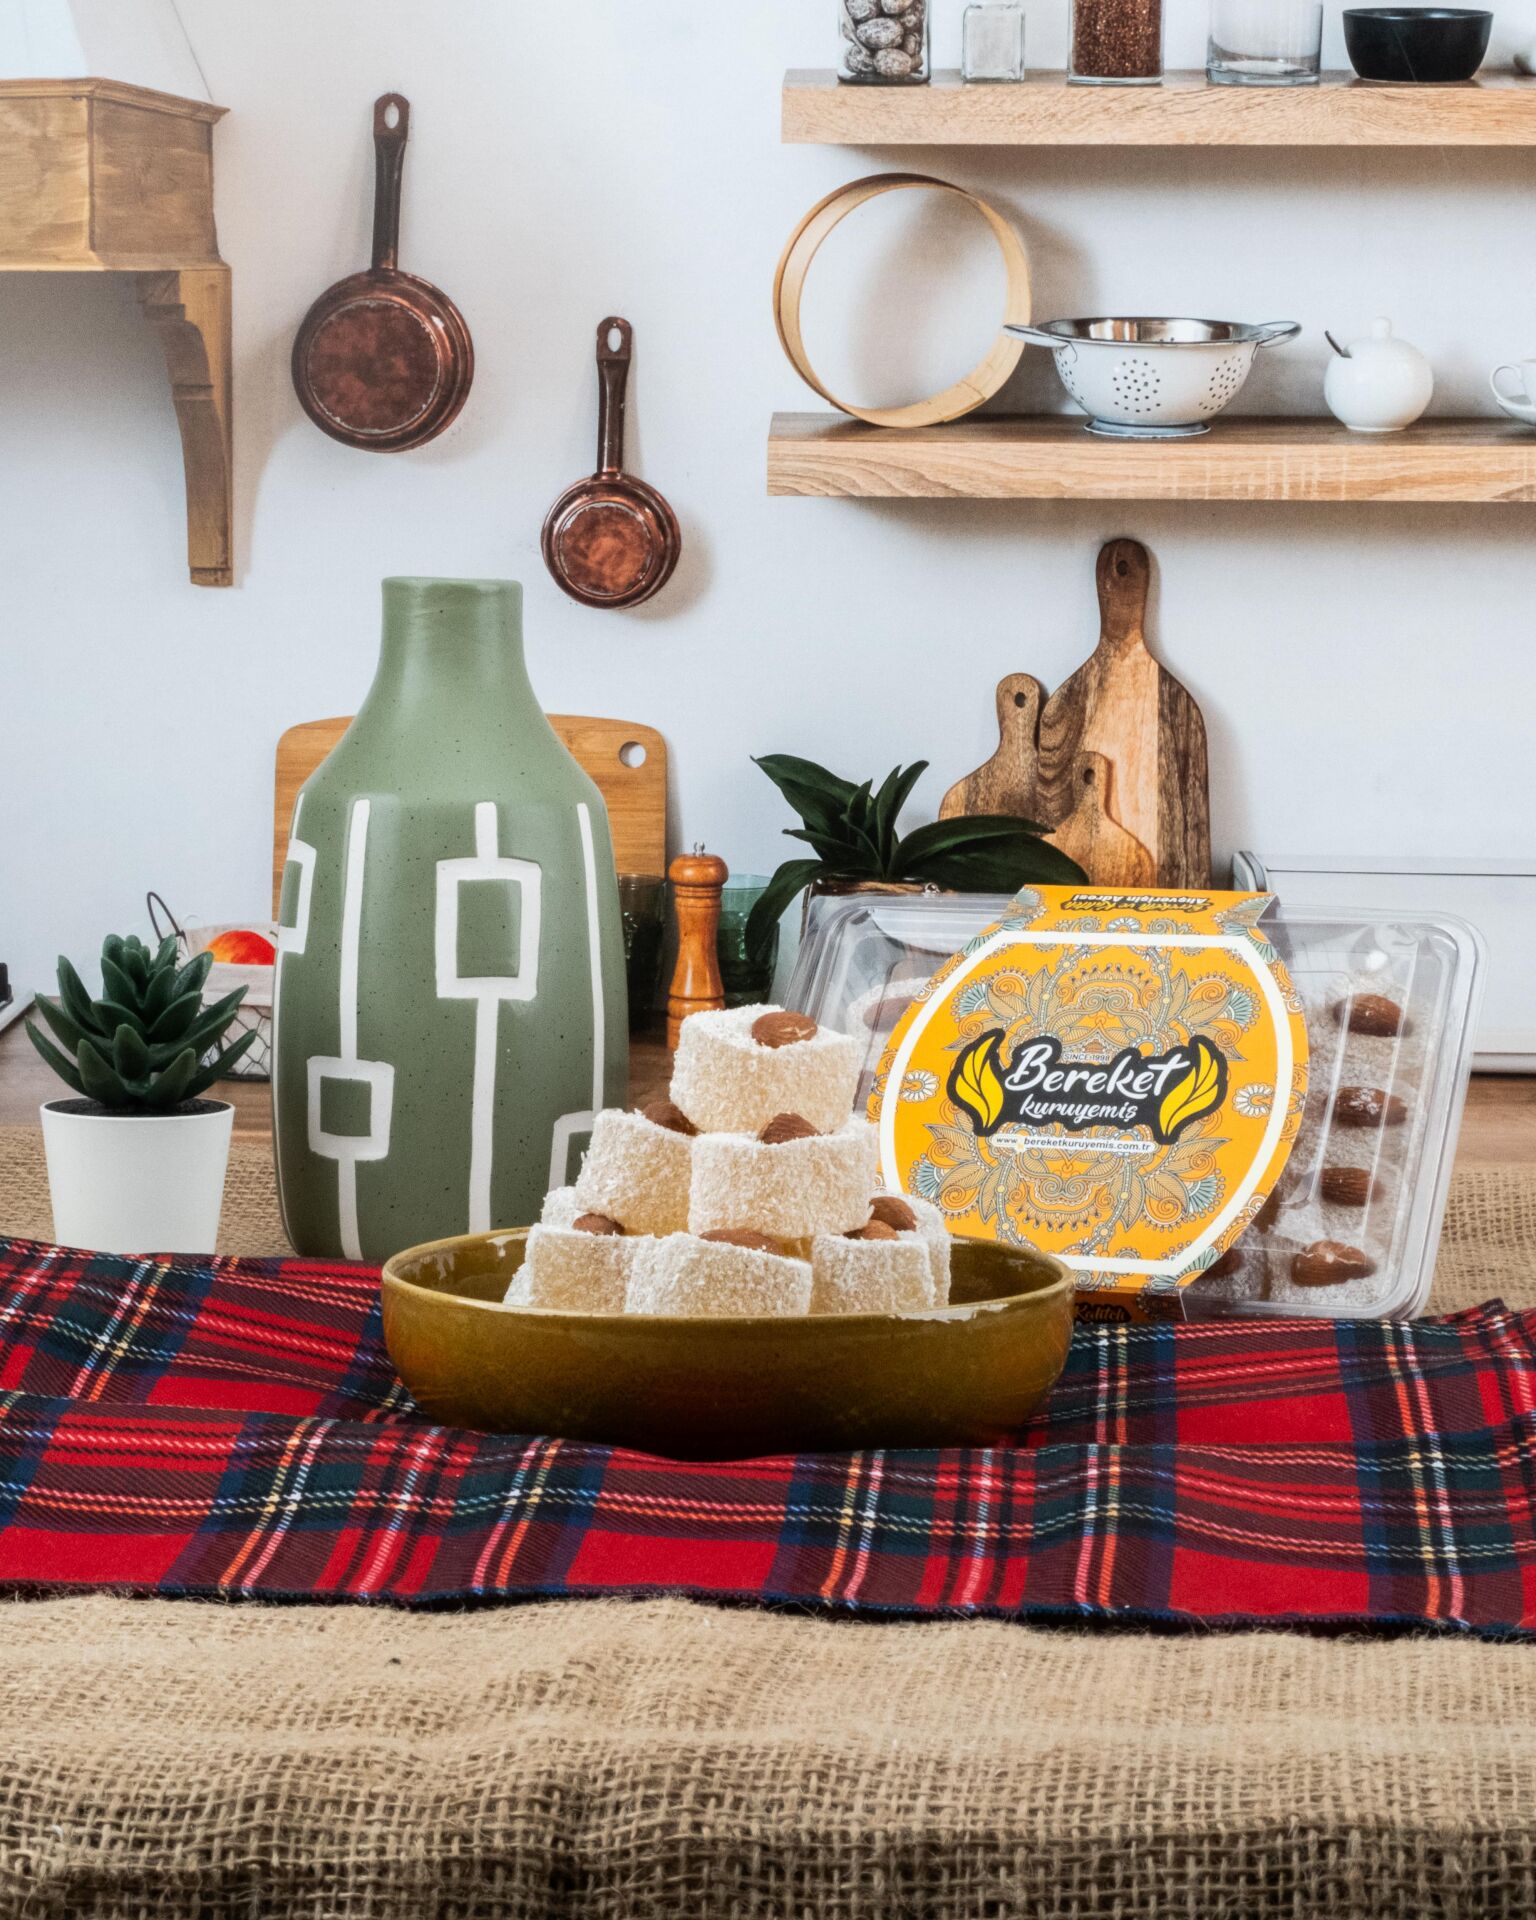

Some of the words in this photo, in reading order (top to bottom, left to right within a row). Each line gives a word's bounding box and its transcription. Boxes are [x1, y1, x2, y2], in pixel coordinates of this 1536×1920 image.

[1005, 1043, 1190, 1099] Bereket
[1019, 1093, 1138, 1122] kuruyemiş
[995, 1136, 1151, 1151] wwwbereketkuruyemis.com.tr
